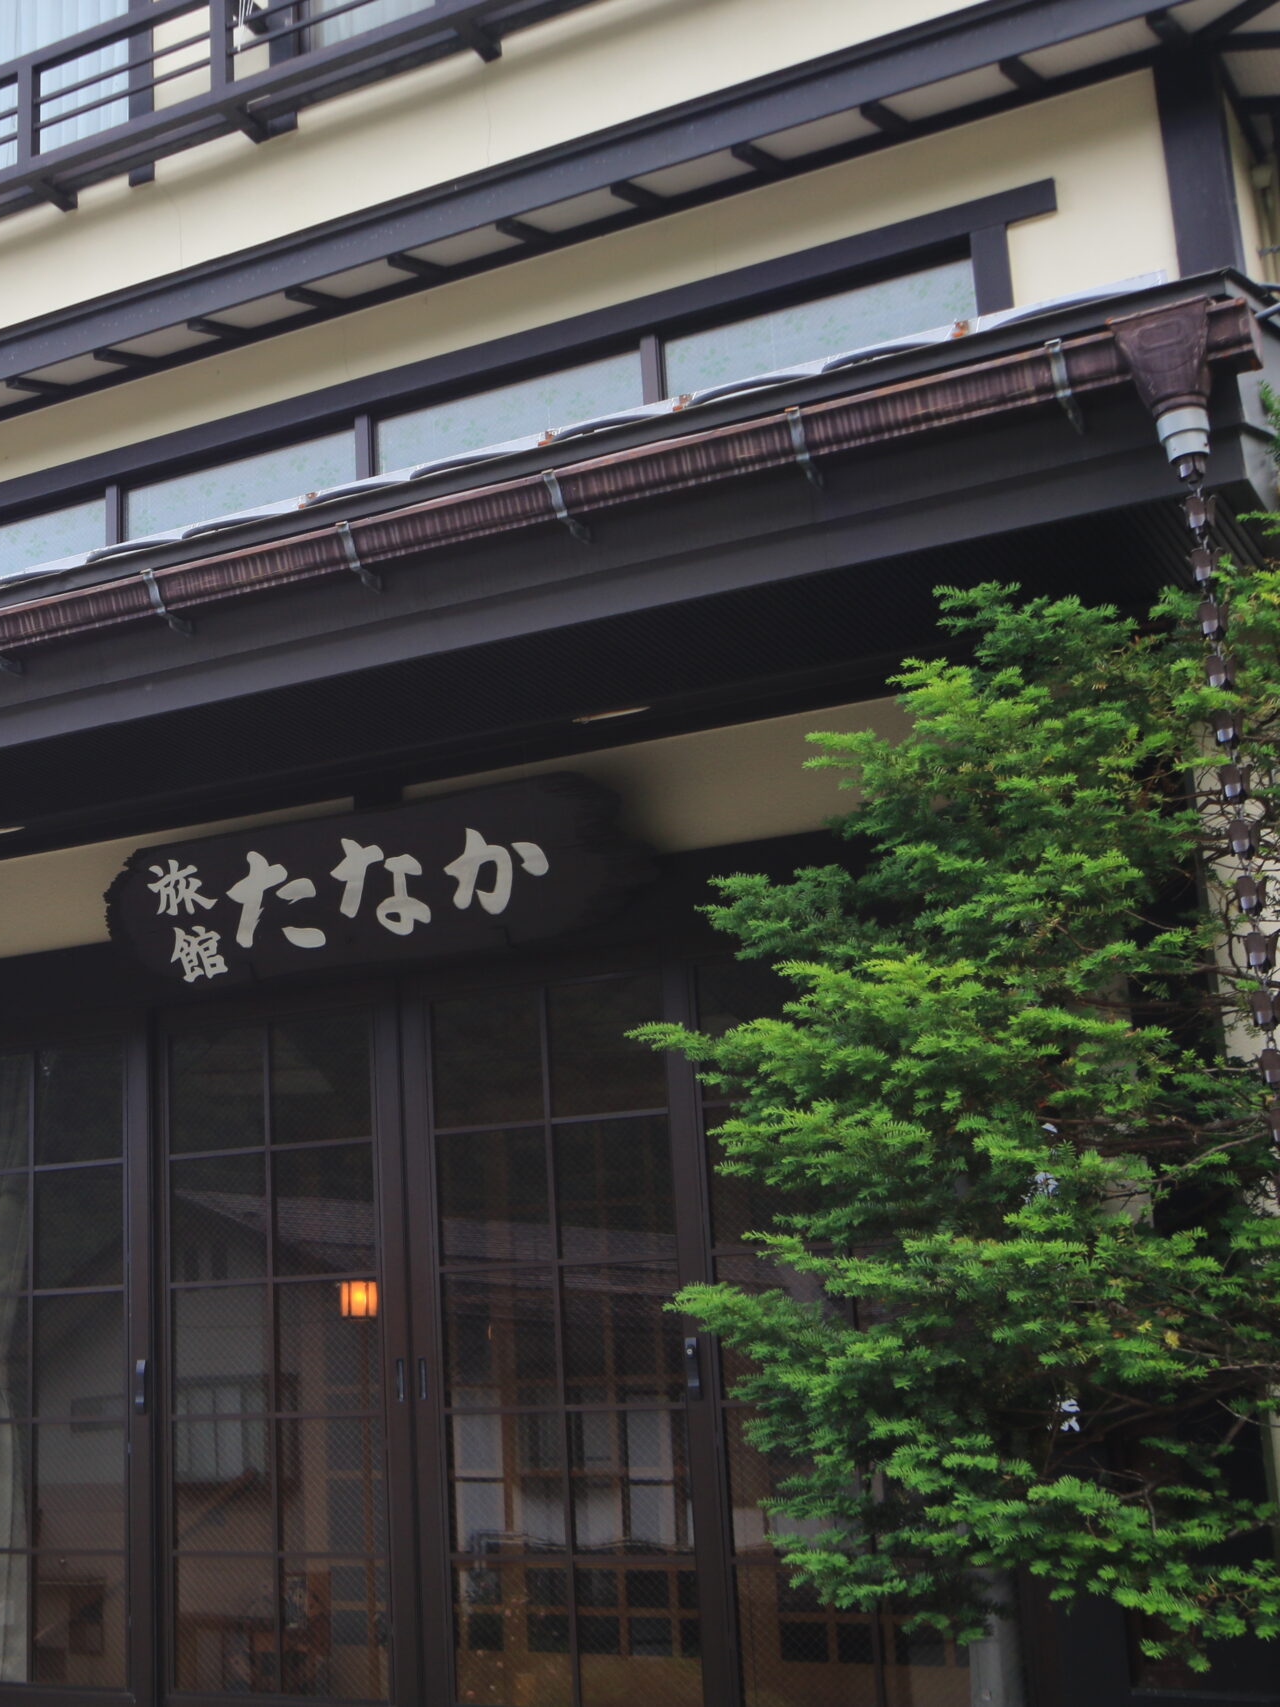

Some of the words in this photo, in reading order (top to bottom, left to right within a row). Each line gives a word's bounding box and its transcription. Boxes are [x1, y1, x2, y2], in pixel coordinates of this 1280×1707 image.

[147, 859, 228, 982] 旅館
[226, 828, 548, 948] たなか
